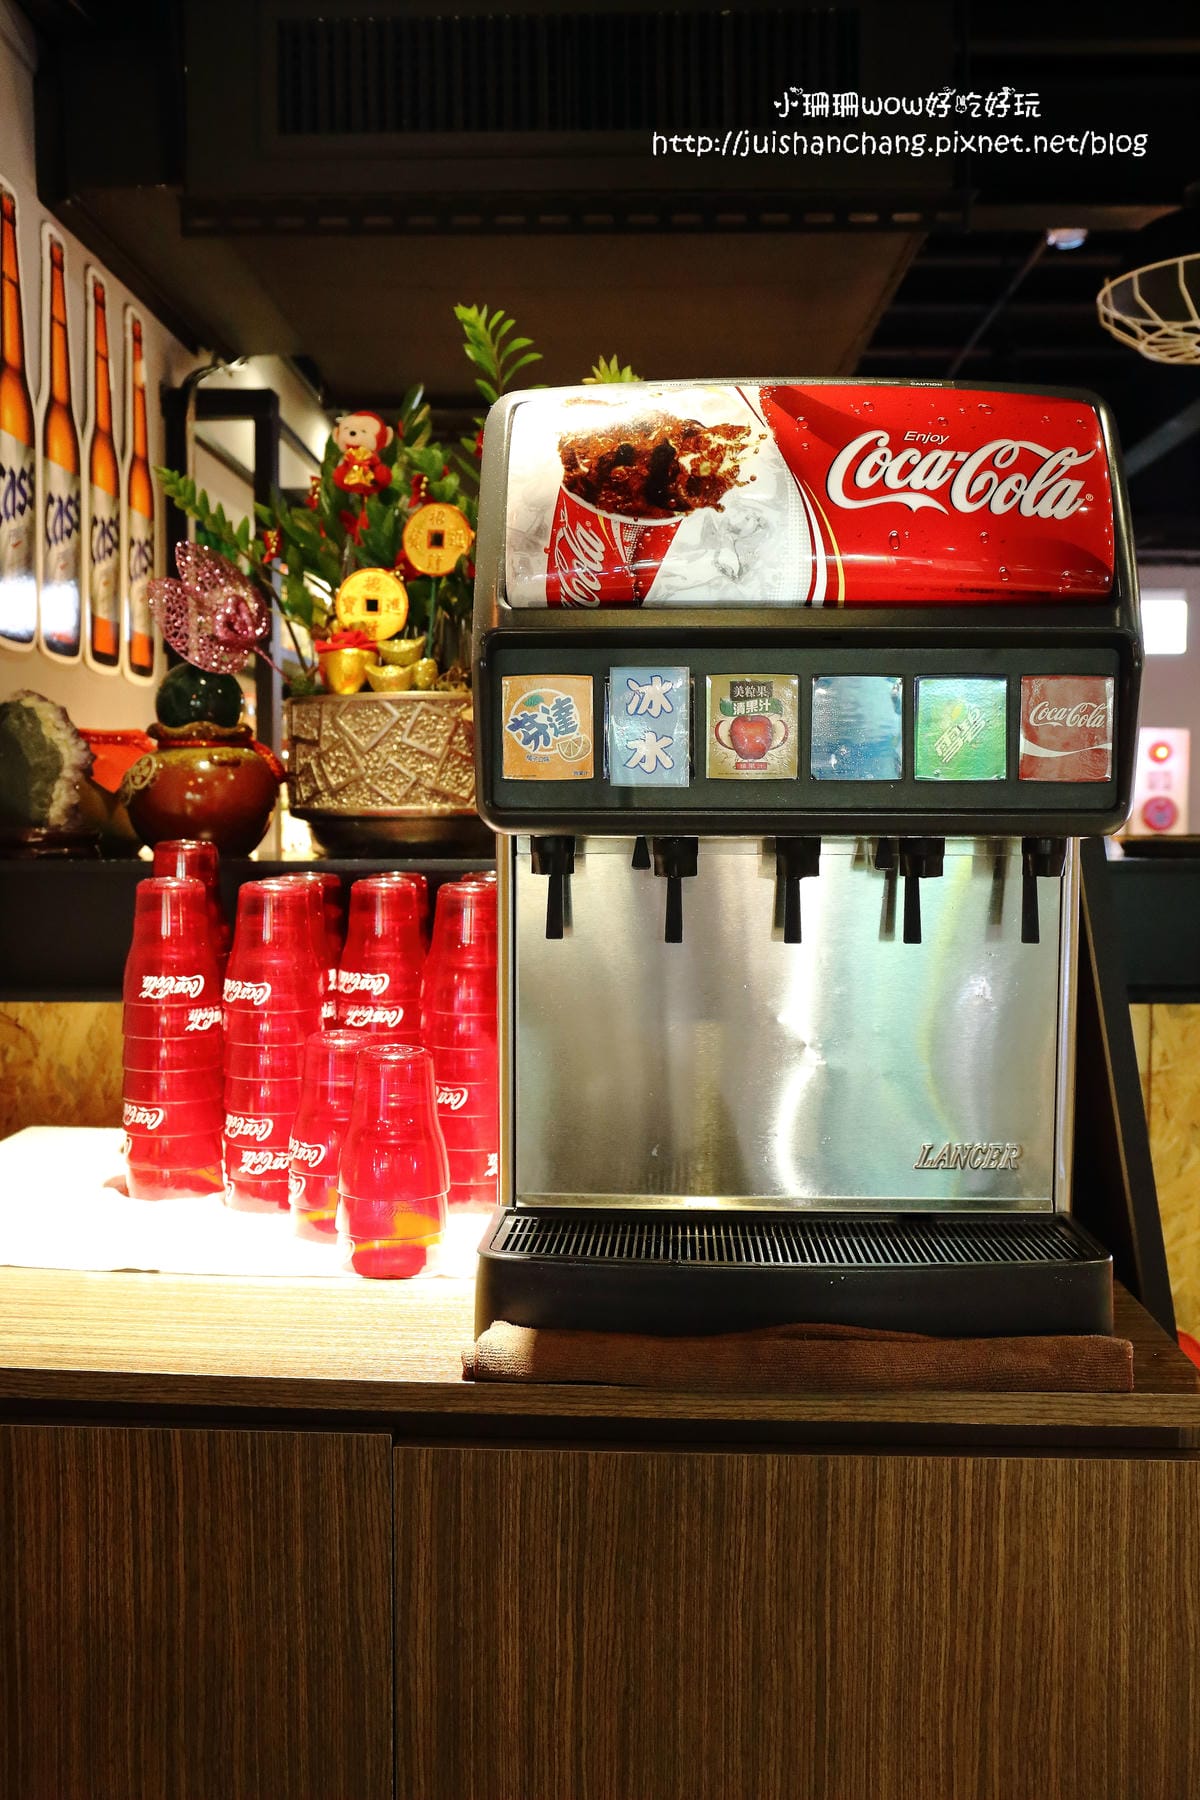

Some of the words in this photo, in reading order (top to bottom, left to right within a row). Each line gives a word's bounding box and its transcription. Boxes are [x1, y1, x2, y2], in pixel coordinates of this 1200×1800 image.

[904, 431, 949, 444] Enjoy
[826, 429, 1096, 520] Coca-Cola
[506, 695, 579, 752] 芬達
[1028, 701, 1109, 729] Coca-Cola
[913, 1142, 1024, 1170] LANCER
